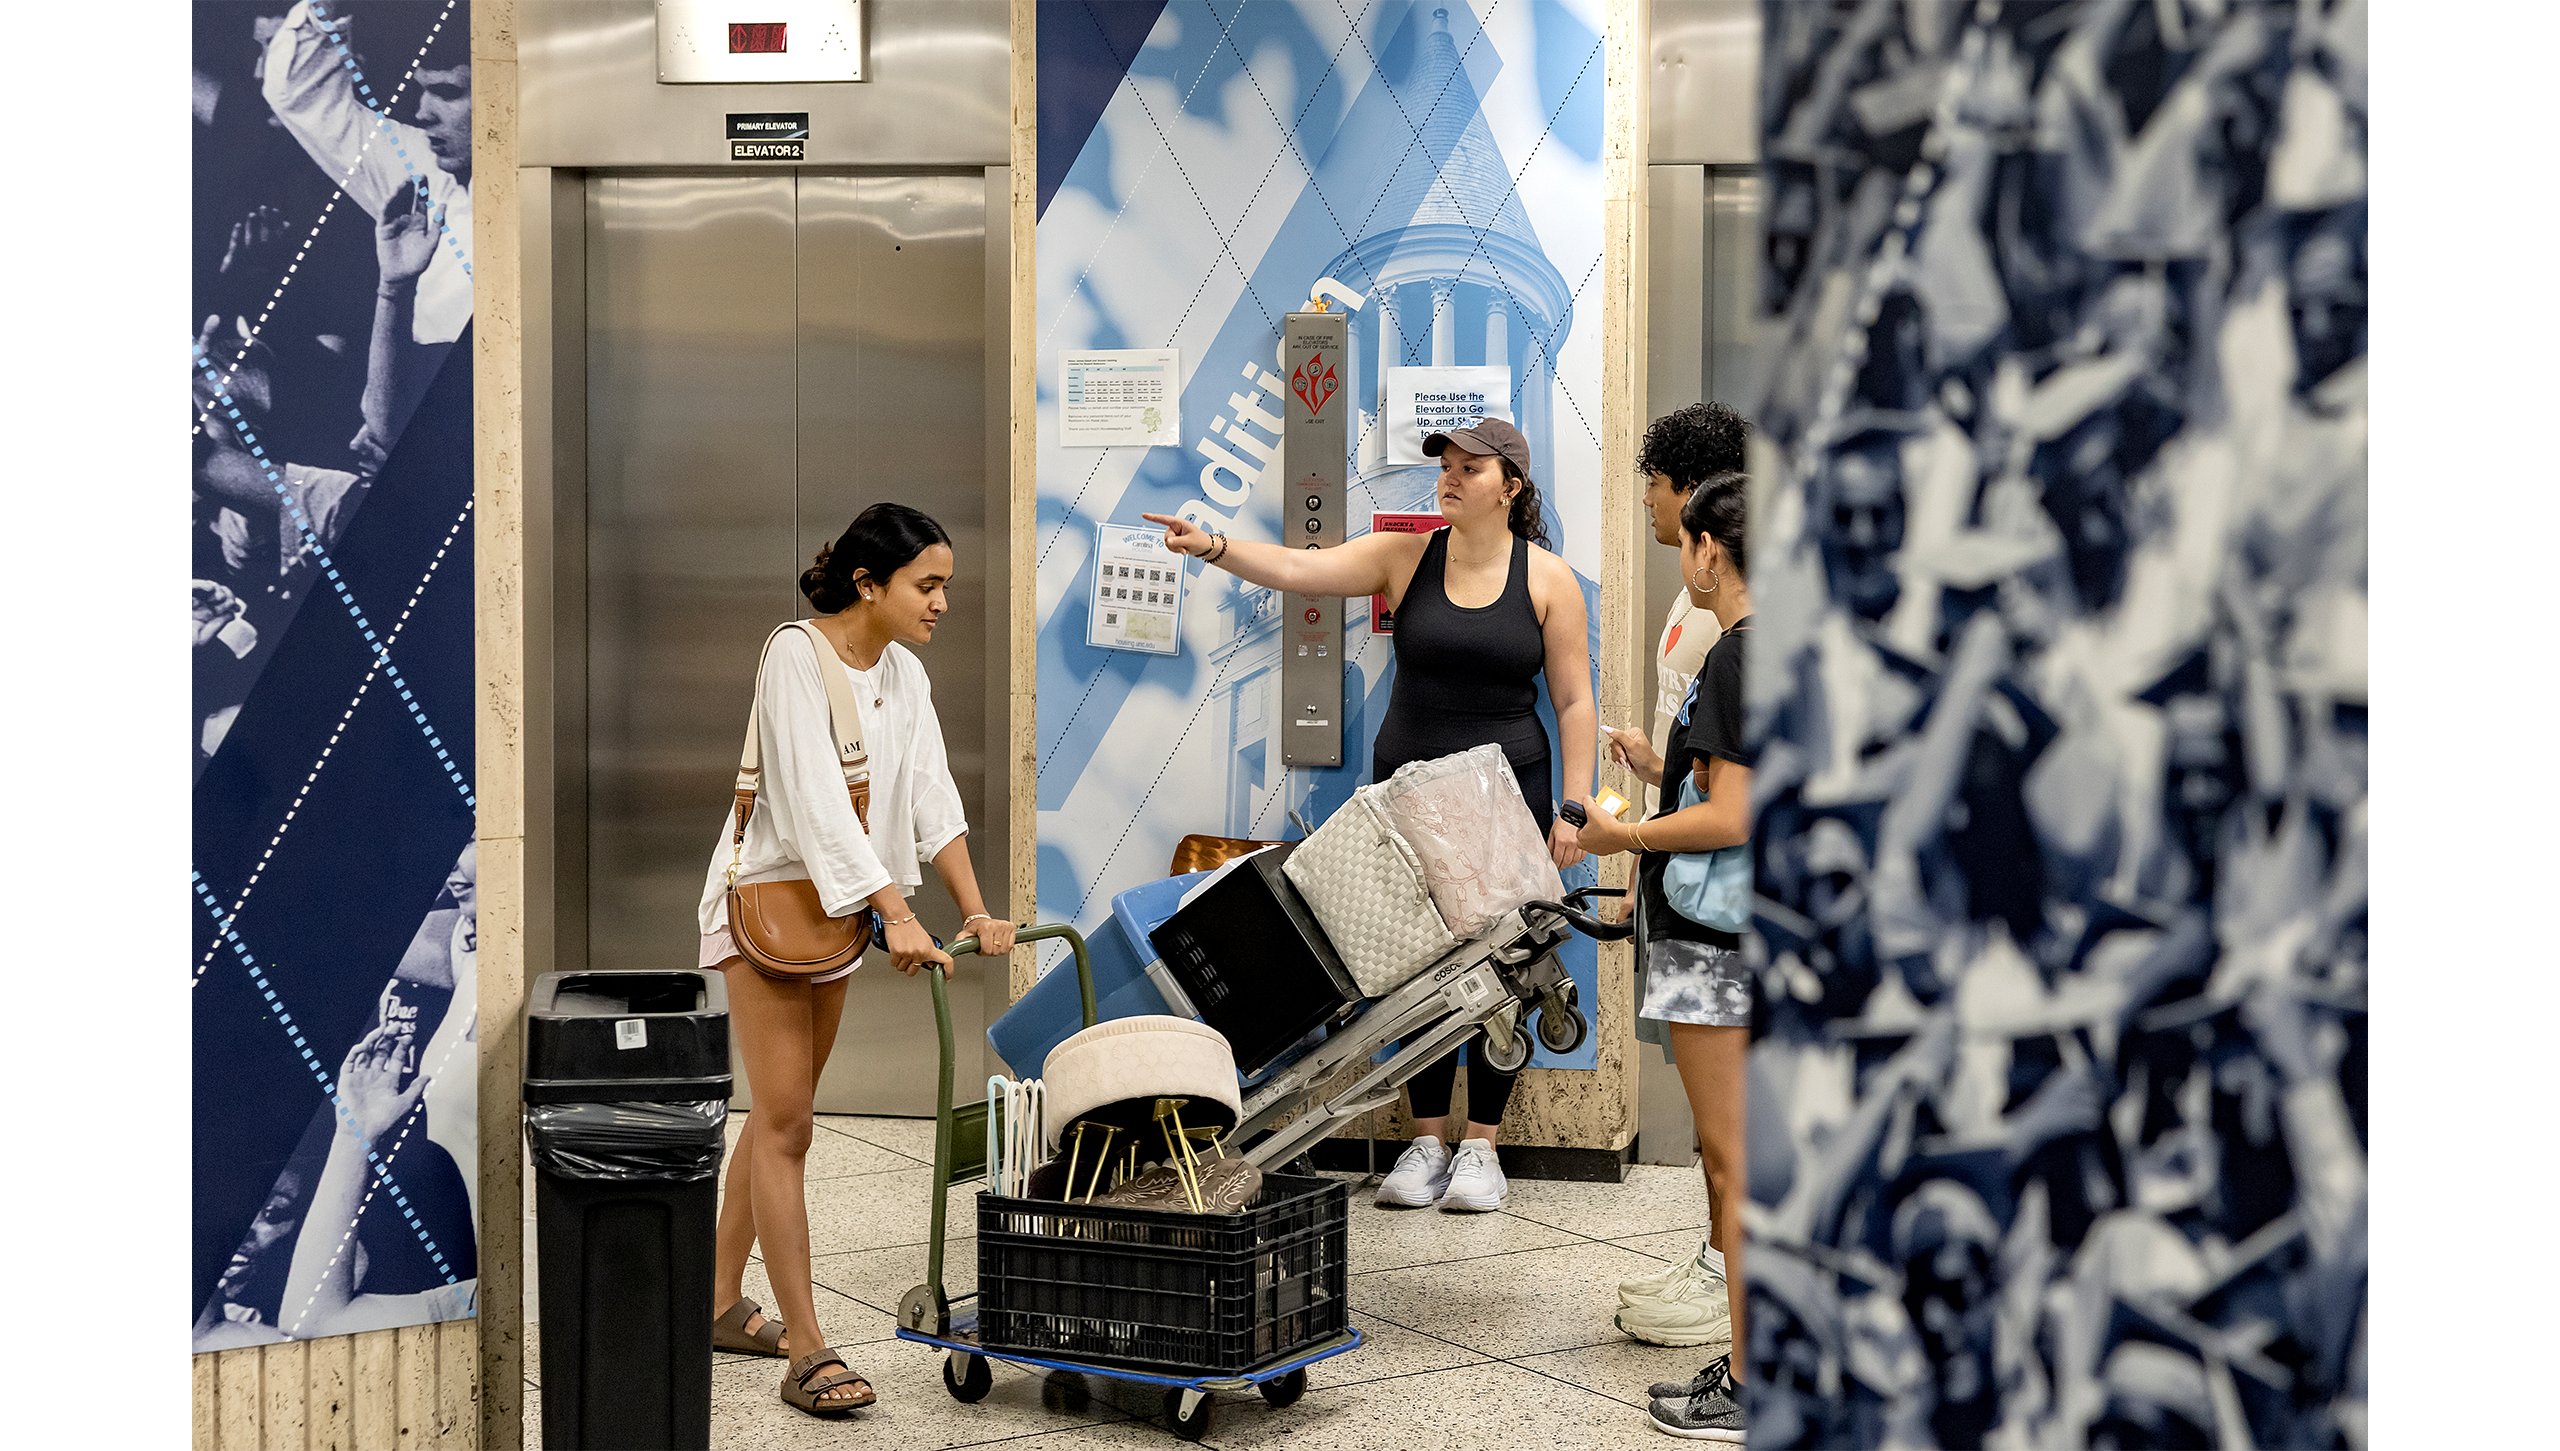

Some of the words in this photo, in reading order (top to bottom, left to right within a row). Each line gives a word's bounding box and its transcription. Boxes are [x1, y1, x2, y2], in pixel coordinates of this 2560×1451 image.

[737, 122, 764, 130] PRIMARY
[765, 122, 797, 130] ELEVATOR
[735, 145, 790, 156] ELEVATOR
[792, 145, 799, 156] 2
[1415, 392, 1447, 401] Please
[1449, 392, 1466, 401] Use
[1469, 392, 1484, 401] the
[1415, 405, 1454, 413] Elevator
[1457, 405, 1466, 413] to
[1469, 404, 1484, 413] Go
[1416, 417, 1432, 427] Up,
[1435, 417, 1455, 426] and
[1122, 533, 1155, 543] WELCOME
[1156, 538, 1165, 548] TO
[1658, 664, 1696, 692] TRY
[844, 741, 861, 755] AM
[1710, 1301, 1730, 1318] HO
